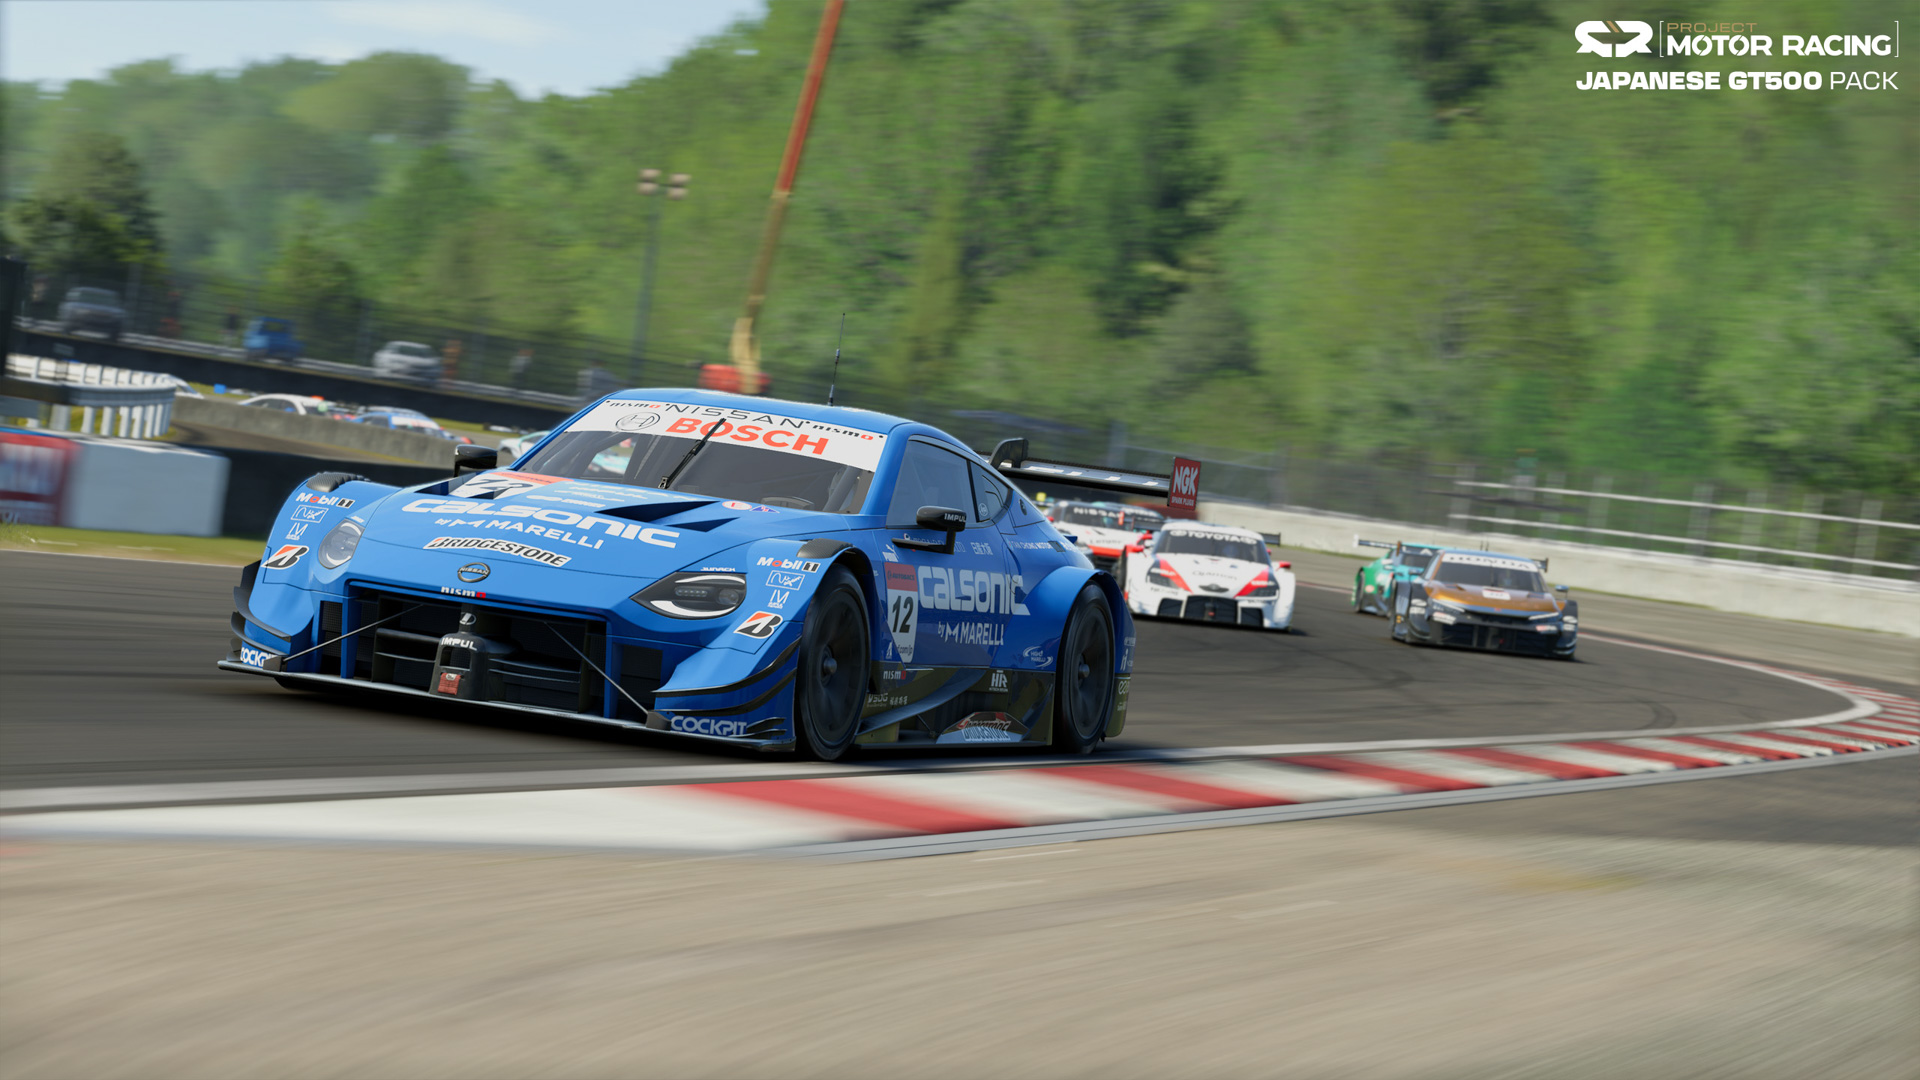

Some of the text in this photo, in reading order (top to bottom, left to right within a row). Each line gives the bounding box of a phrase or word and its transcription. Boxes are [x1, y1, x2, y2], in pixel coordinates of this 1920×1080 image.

[665, 404, 804, 429] NISSAN
[665, 417, 829, 455] BOSCH
[1172, 465, 1198, 497] NGK
[296, 492, 339, 506] Mobil
[485, 519, 604, 550] MARELLI
[1188, 531, 1240, 543] TOYOTA
[427, 537, 568, 566] BRIDGESTONE
[757, 557, 803, 570] Mobil
[892, 595, 914, 633] 12
[441, 637, 477, 651] IMPUL
[938, 621, 946, 638] by
[960, 621, 1004, 646] MARELLI
[670, 715, 748, 736] COCKPIT
